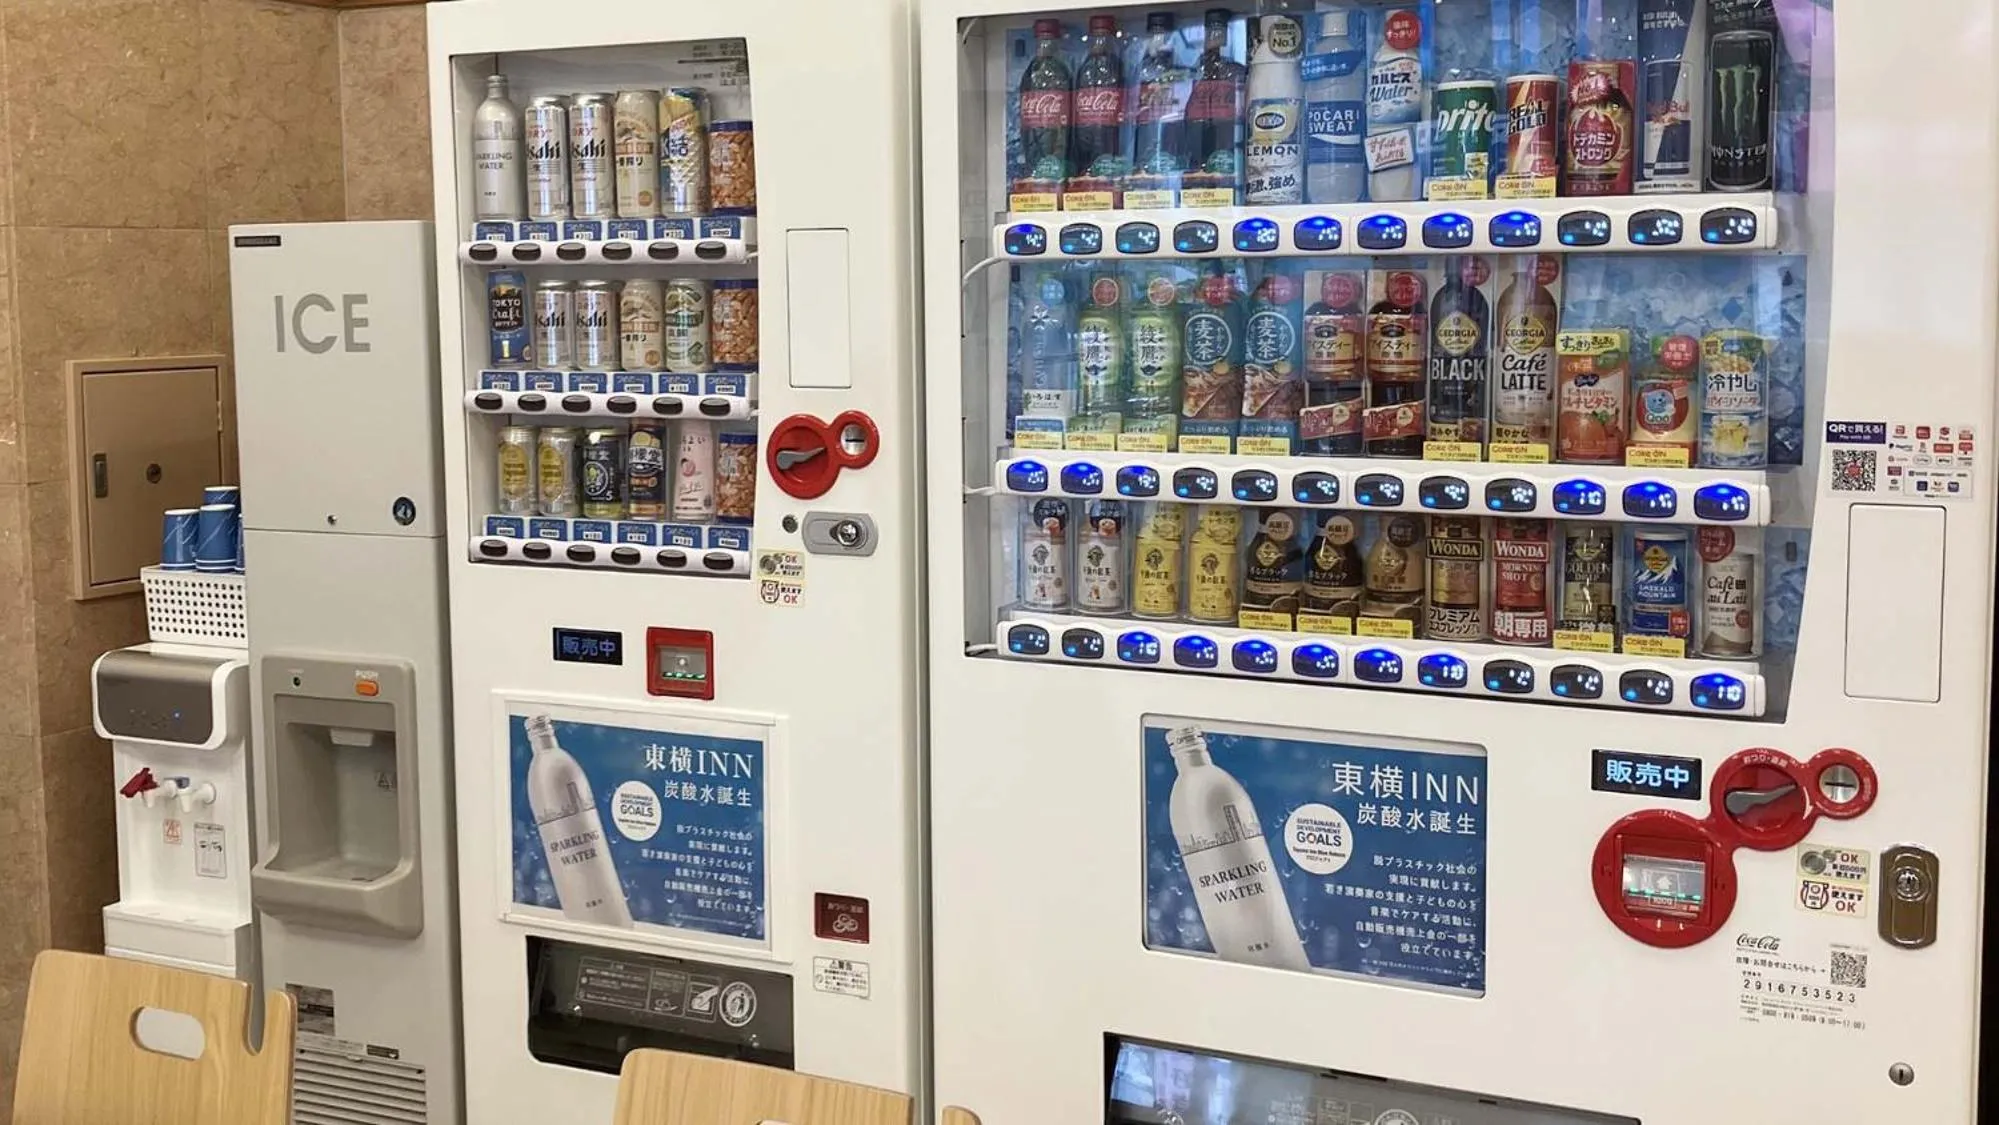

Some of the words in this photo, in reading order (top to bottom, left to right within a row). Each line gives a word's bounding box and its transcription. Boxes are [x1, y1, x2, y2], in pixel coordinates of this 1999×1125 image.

[1309, 110, 1360, 122] POCARI
[1510, 100, 1545, 119] REAL
[1508, 111, 1547, 136] GOLD
[274, 293, 371, 354] ICE
[1505, 328, 1545, 338] GEORGIA
[1195, 319, 1214, 360] 麦茶
[1257, 316, 1277, 358] 麦茶
[1438, 329, 1478, 338] GEORGIA
[1432, 359, 1485, 381] BLACK
[1502, 354, 1547, 372] Café
[1501, 373, 1547, 391] LATTE
[1708, 374, 1757, 392] 冷やし
[1431, 540, 1478, 556] WONDA
[1495, 540, 1544, 558] WONDA
[1502, 572, 1527, 581] SHOT
[783, 595, 798, 604] OK
[1494, 611, 1548, 638] 朝専用
[562, 636, 616, 656] 販売中
[643, 744, 754, 779] 東横INN
[1331, 761, 1478, 805] 東横INN
[1606, 759, 1690, 789] 販売中
[664, 780, 752, 807] 炭酸水誕生
[620, 805, 654, 818] GOALS
[1357, 803, 1477, 835] 炭酸水誕生
[1296, 825, 1341, 834] DEVELOPMENT
[1297, 818, 1342, 828] SUSTAINABLE
[550, 830, 600, 854] SPARKLING
[1296, 832, 1342, 847] GOALS
[560, 849, 598, 867] WATER
[1373, 855, 1477, 875] 脱プラスチック社会の
[1841, 853, 1859, 863] OK
[1199, 861, 1268, 889] SPARKLING
[1389, 874, 1477, 893] 実現に貢献します。
[1214, 882, 1265, 905] WATER
[1835, 900, 1856, 913] OK
[1743, 978, 1856, 1003] 2916753523
